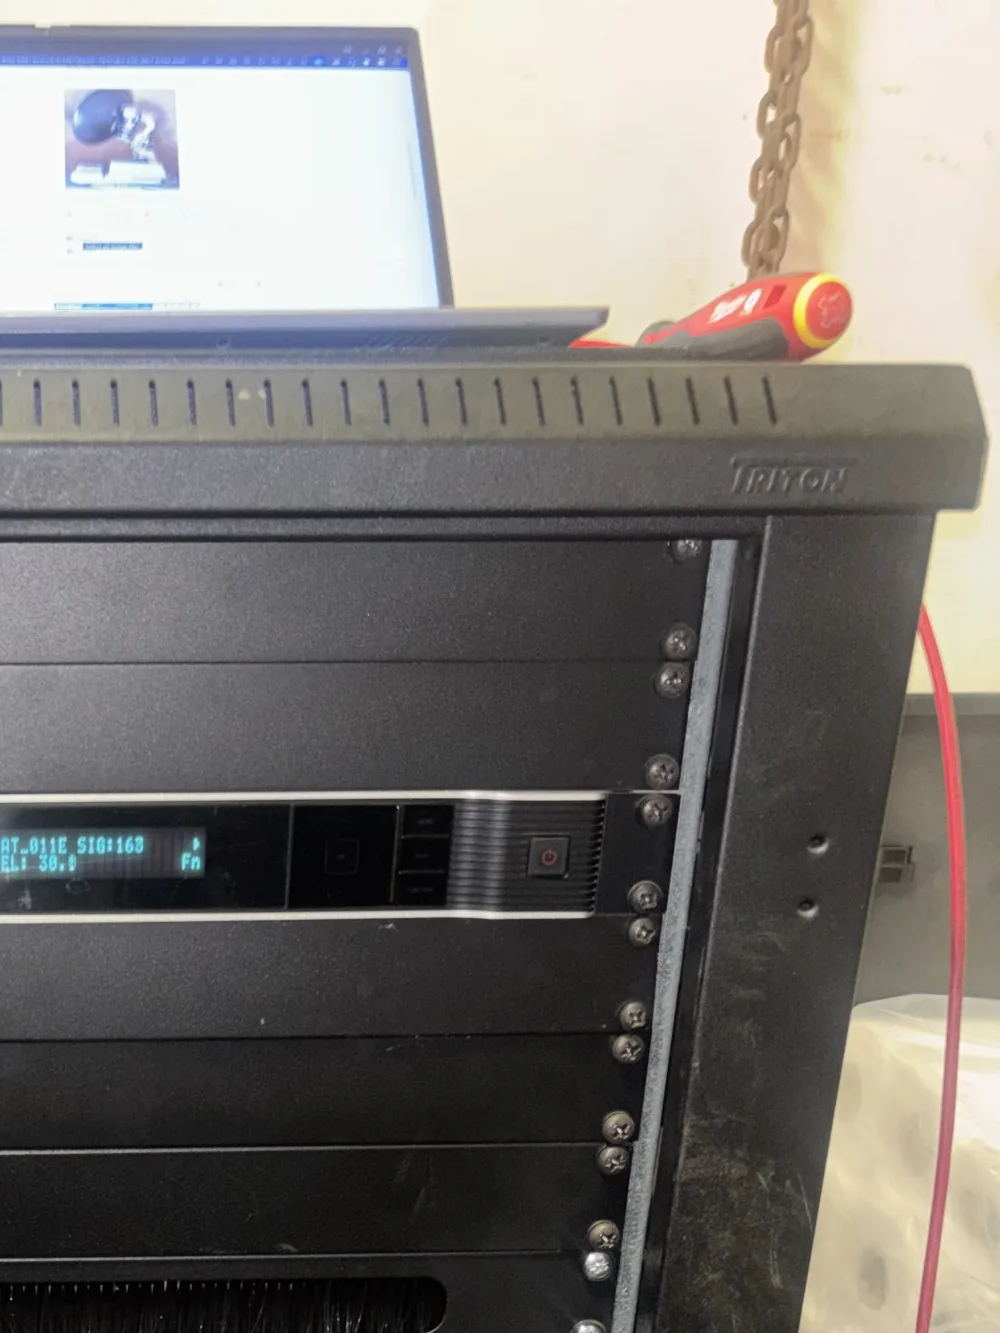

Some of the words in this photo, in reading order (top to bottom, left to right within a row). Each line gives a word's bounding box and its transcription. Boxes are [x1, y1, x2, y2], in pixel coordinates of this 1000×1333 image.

[730, 458, 850, 493] TRITON
[1, 854, 27, 873] EL:
[180, 852, 201, 871] Fn
